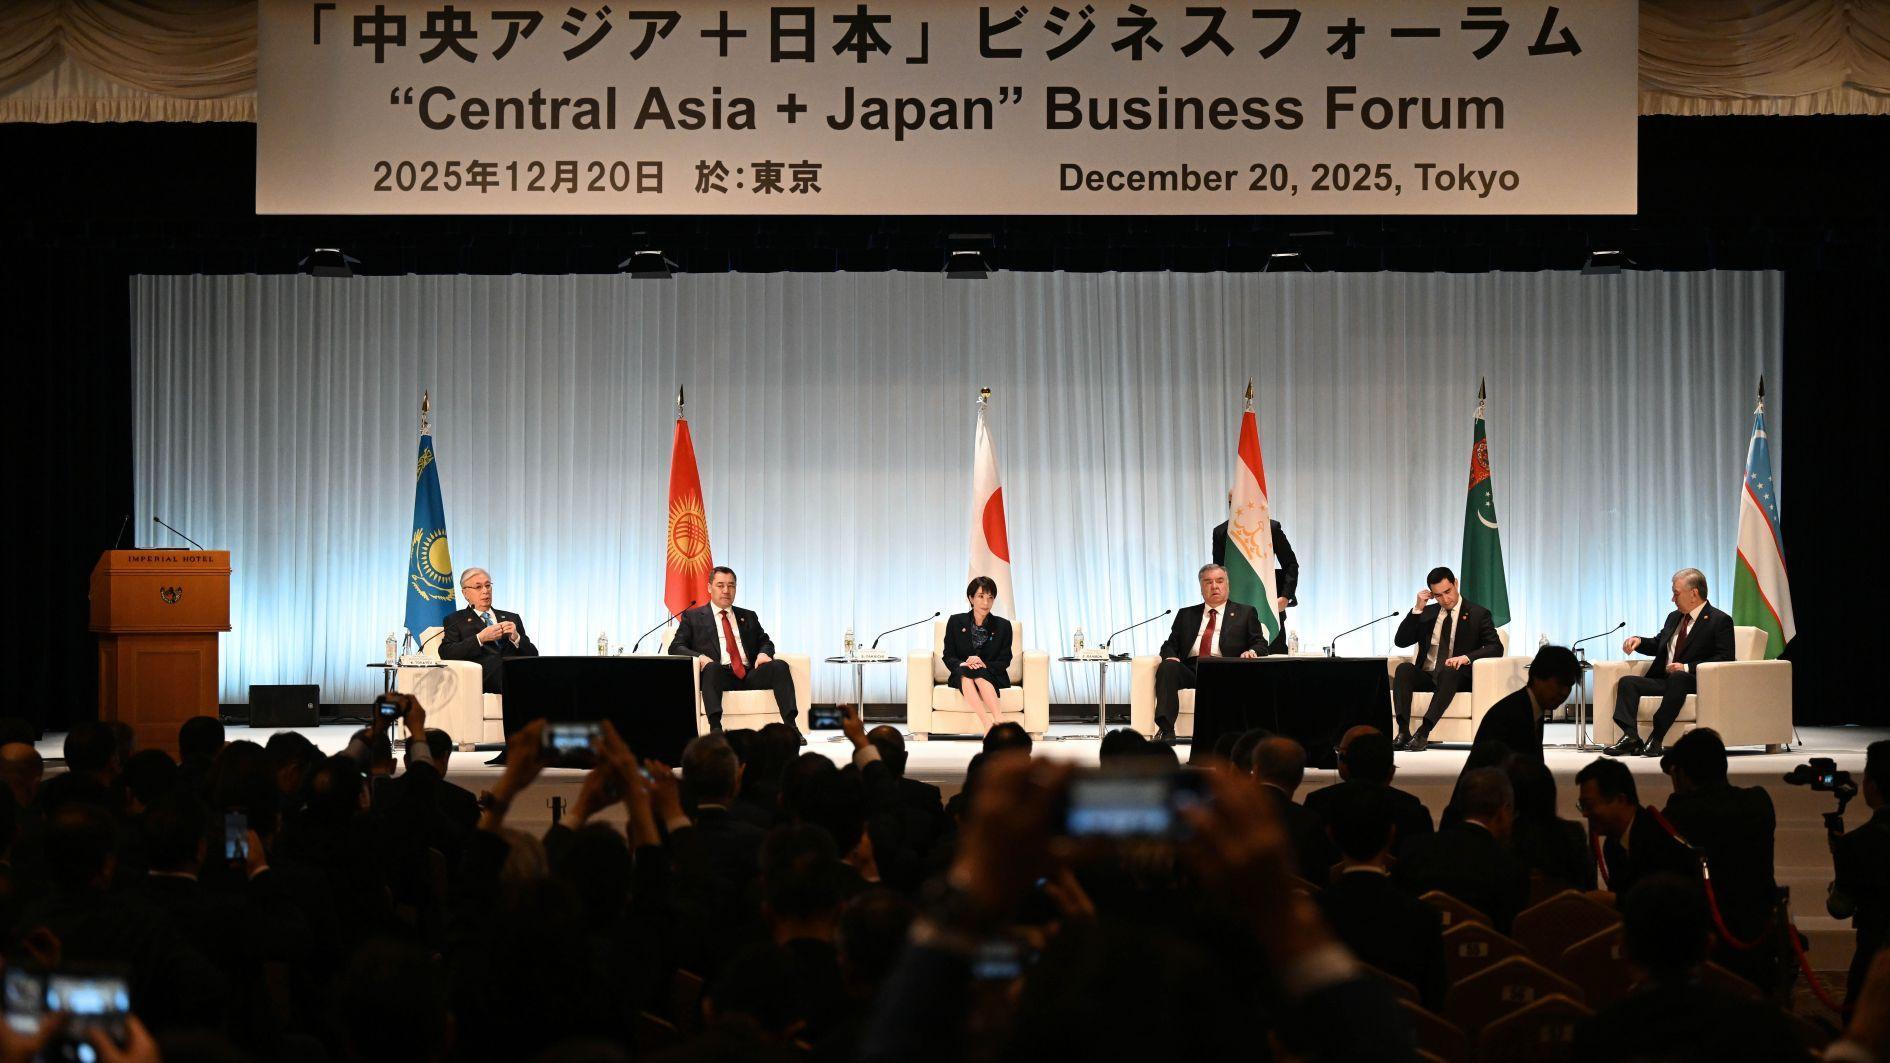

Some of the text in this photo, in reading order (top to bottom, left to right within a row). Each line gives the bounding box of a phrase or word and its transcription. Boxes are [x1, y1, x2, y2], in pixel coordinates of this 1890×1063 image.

[390, 86, 1505, 142] “Central Asia + Japan” Business Forum
[373, 160, 663, 193] 2025年12月20日
[1060, 163, 1520, 199] December 20, 2025, Tokyo
[128, 555, 214, 563] IMPERIAL HOTEL
